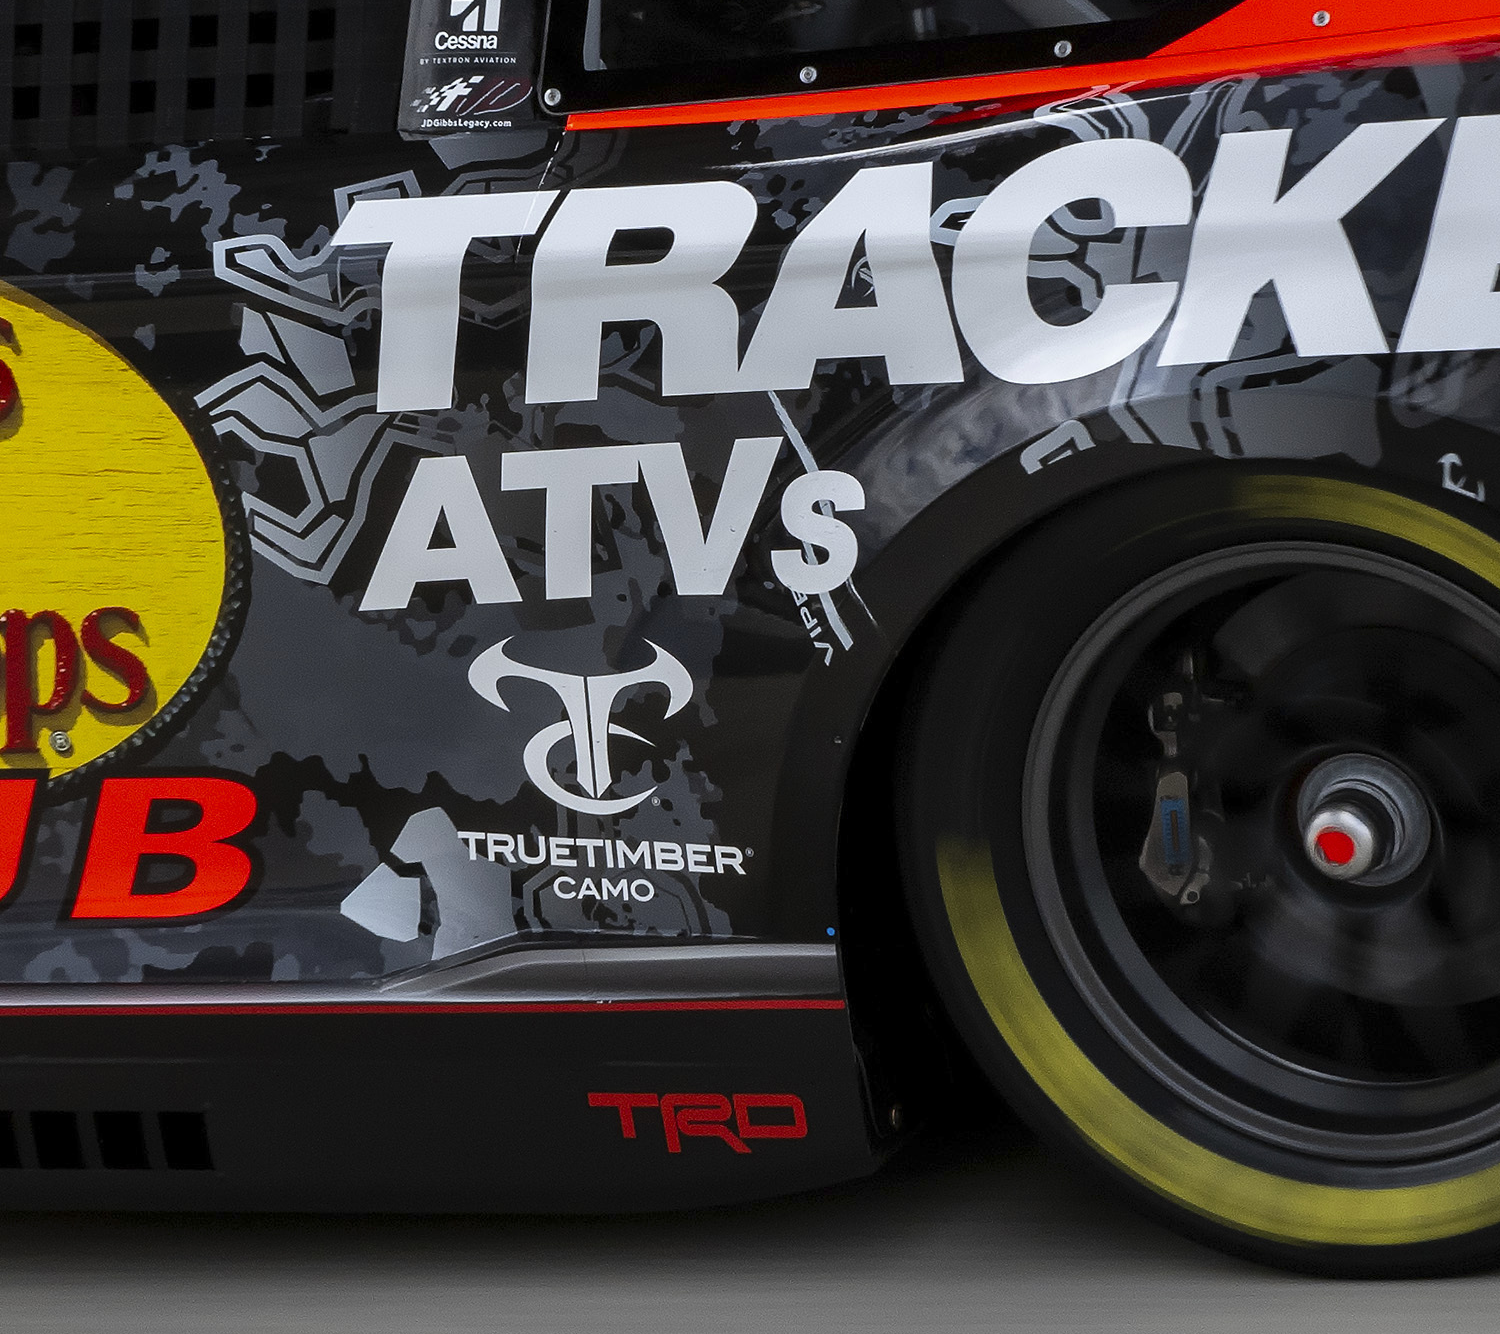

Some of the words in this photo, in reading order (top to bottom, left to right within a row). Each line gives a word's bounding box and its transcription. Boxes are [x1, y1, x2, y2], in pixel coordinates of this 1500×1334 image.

[434, 31, 499, 51] Cessna
[432, 56, 471, 65] TEXTRON
[473, 56, 518, 64] AVIATION
[420, 118, 513, 130] JDGibbsLegacy.com
[458, 830, 747, 876] TRUETIMBER
[552, 875, 655, 903] CAMO
[587, 1092, 808, 1155] TRD
